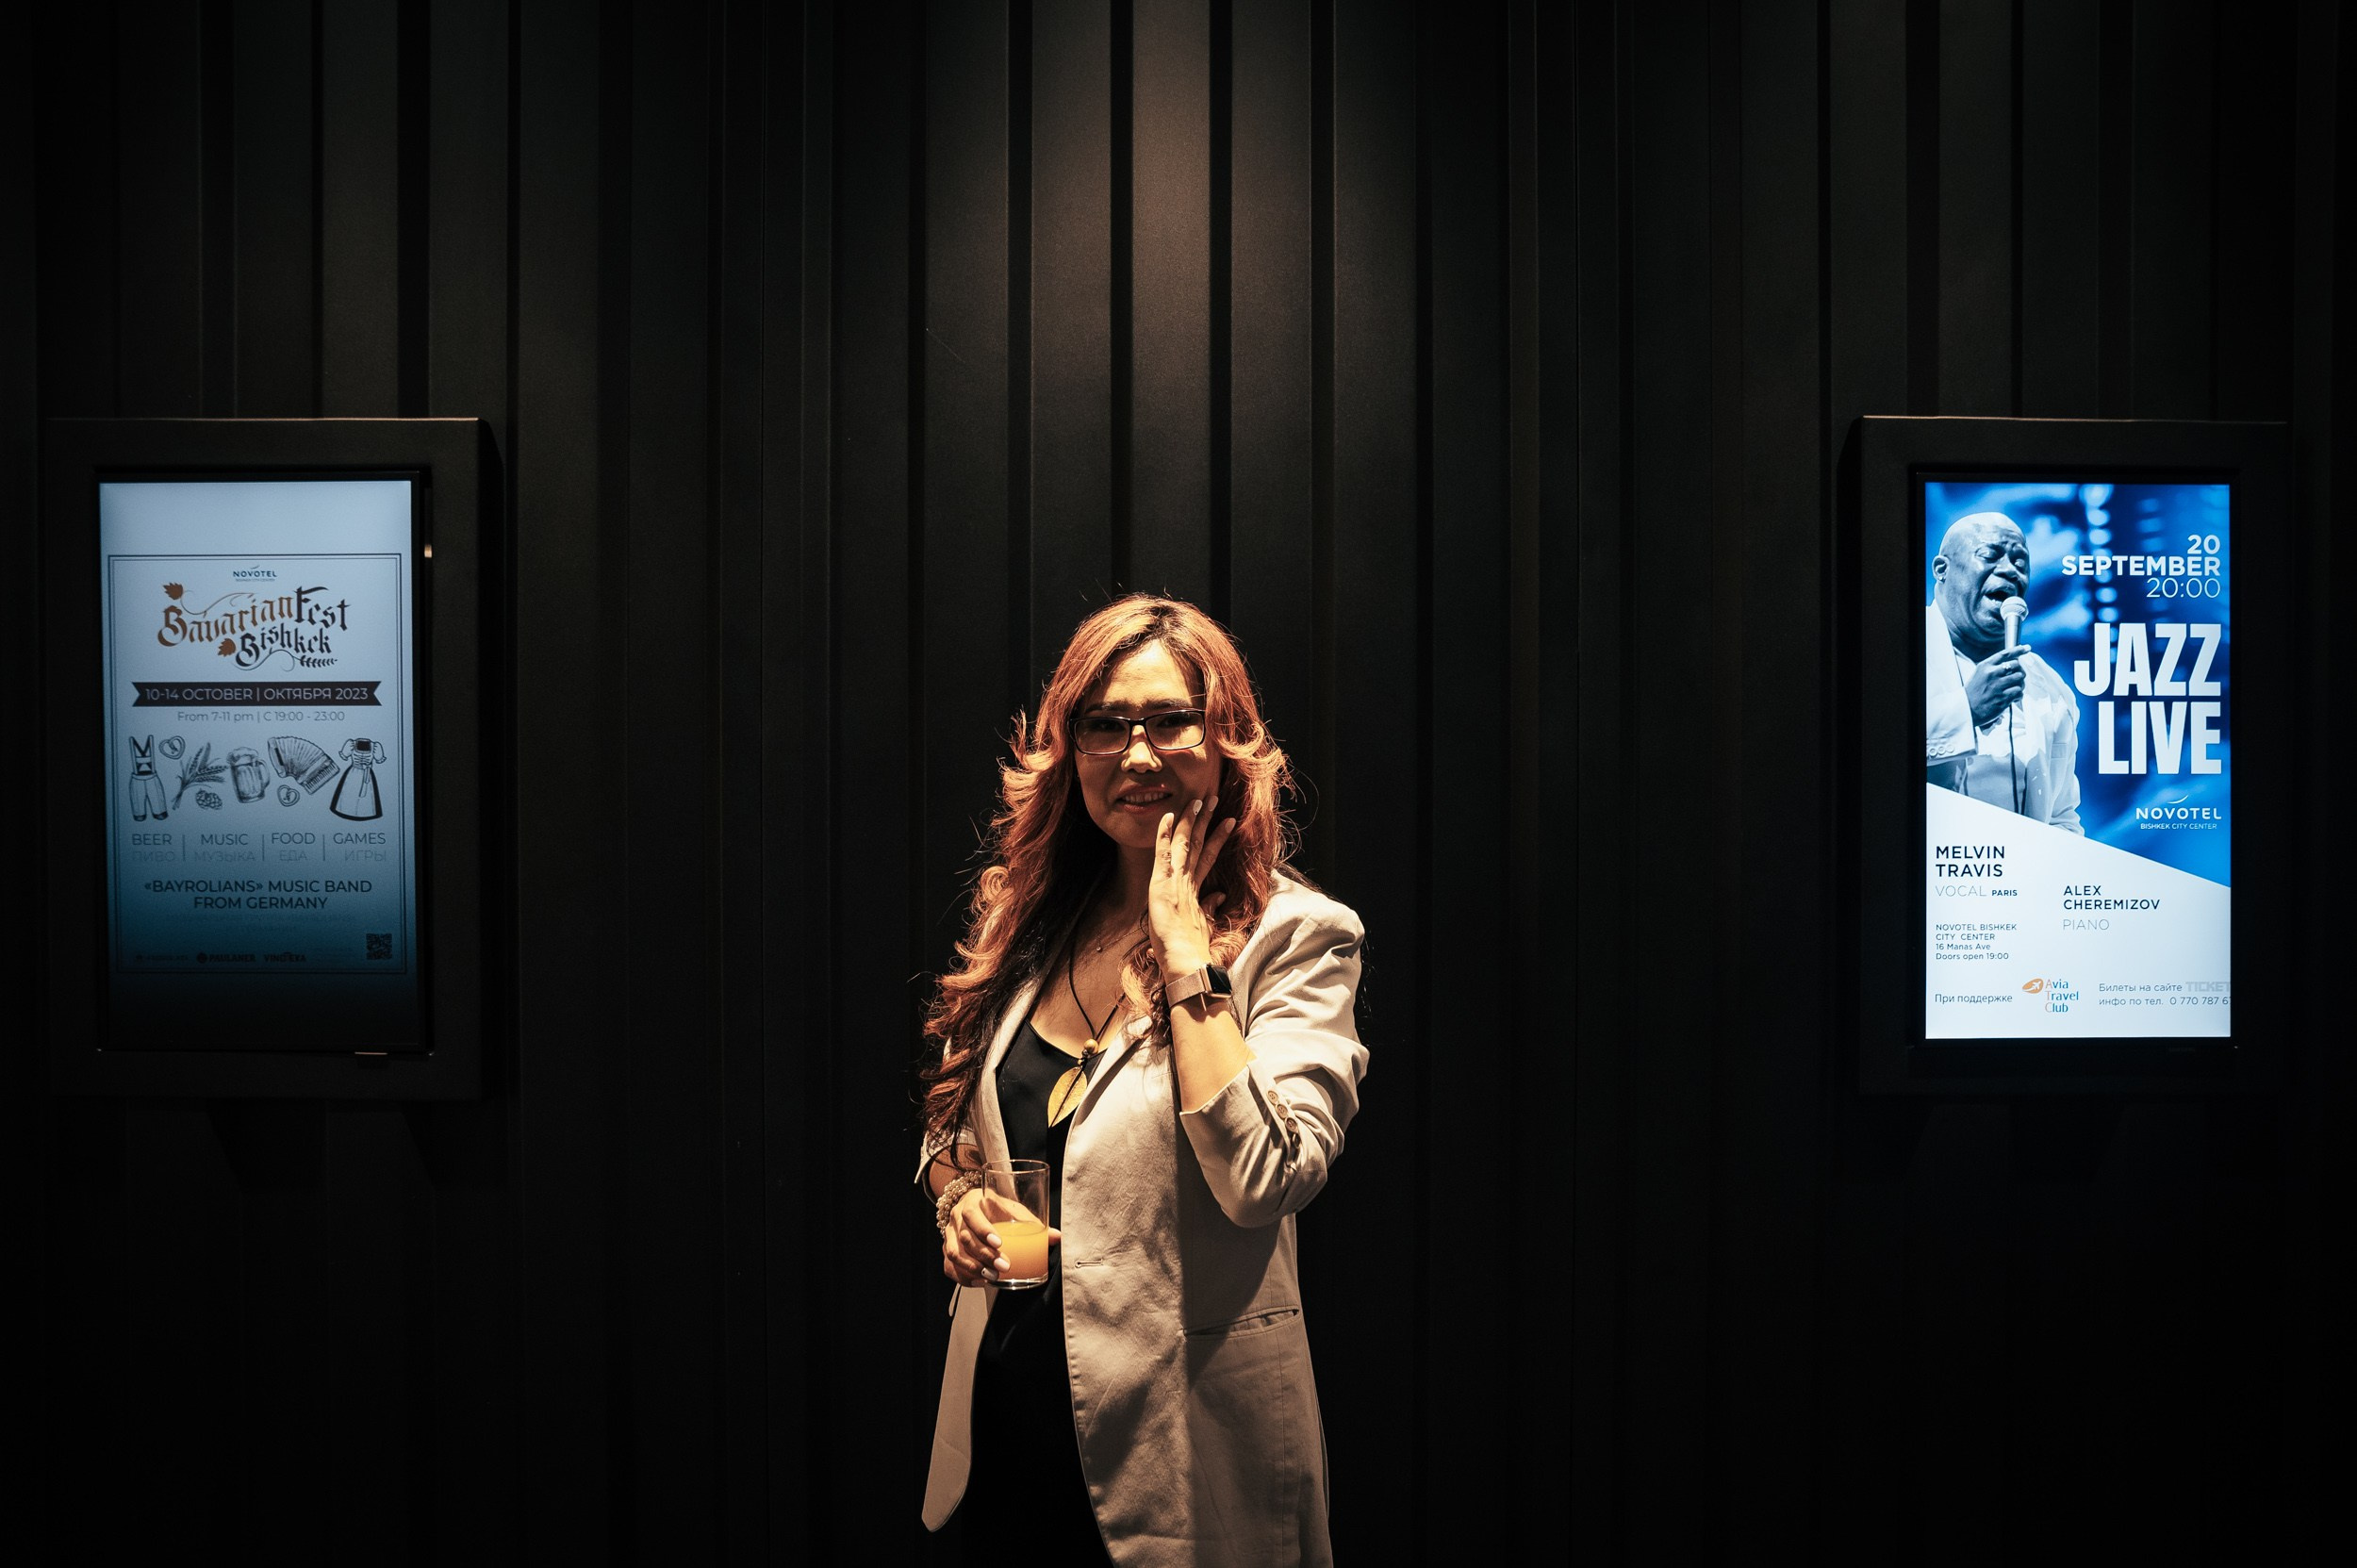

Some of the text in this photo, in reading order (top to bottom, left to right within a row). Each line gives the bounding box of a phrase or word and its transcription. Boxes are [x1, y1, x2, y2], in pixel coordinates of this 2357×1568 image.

[2187, 534, 2221, 554] 20
[2061, 555, 2221, 576] SEPTEMBER
[2146, 578, 2221, 599] 20:00
[236, 622, 332, 668] Bishkek
[2073, 623, 2221, 697] JAZZ
[145, 687, 369, 701] 10-14 OCTOBER ОКТЯБРЯ 2023
[177, 711, 208, 721] From
[211, 711, 231, 721] 7-11
[234, 713, 254, 723] pm
[274, 711, 304, 721] 19:00
[314, 711, 345, 721] 23:00
[2098, 701, 2222, 774] LIVE
[2135, 807, 2222, 819] NOVOTEL
[132, 832, 387, 846] BEER MUSIC FOOD GAMES
[194, 850, 256, 862] МУЗЫКА
[280, 850, 307, 862] ЕДА
[344, 850, 387, 862] ИГРЫ
[1936, 846, 2004, 859] MELVIN
[1936, 864, 2003, 878] TRAVIS
[144, 880, 372, 893] «BAYROLIANS» MUSIC BAND
[1935, 885, 1987, 897] VOCAL
[2063, 885, 2102, 896] ALEX
[194, 897, 328, 909] FROM GERMANY
[2063, 899, 2160, 910] CHEREMIZOV
[1936, 923, 2018, 932] NOVOTEL BISHKEK
[2063, 918, 2110, 931] PIANO
[2045, 979, 2069, 989] Avia
[2099, 982, 2136, 992] Билеты
[2153, 982, 2183, 992] сайте
[1935, 994, 2013, 1004] При поддержке
[2045, 991, 2079, 1001] Travel
[2099, 997, 2127, 1007] инфо
[2169, 996, 2177, 1005] 0
[2180, 996, 2199, 1005] 770
[2201, 996, 2219, 1005] 787
[2045, 1002, 2069, 1013] Club
